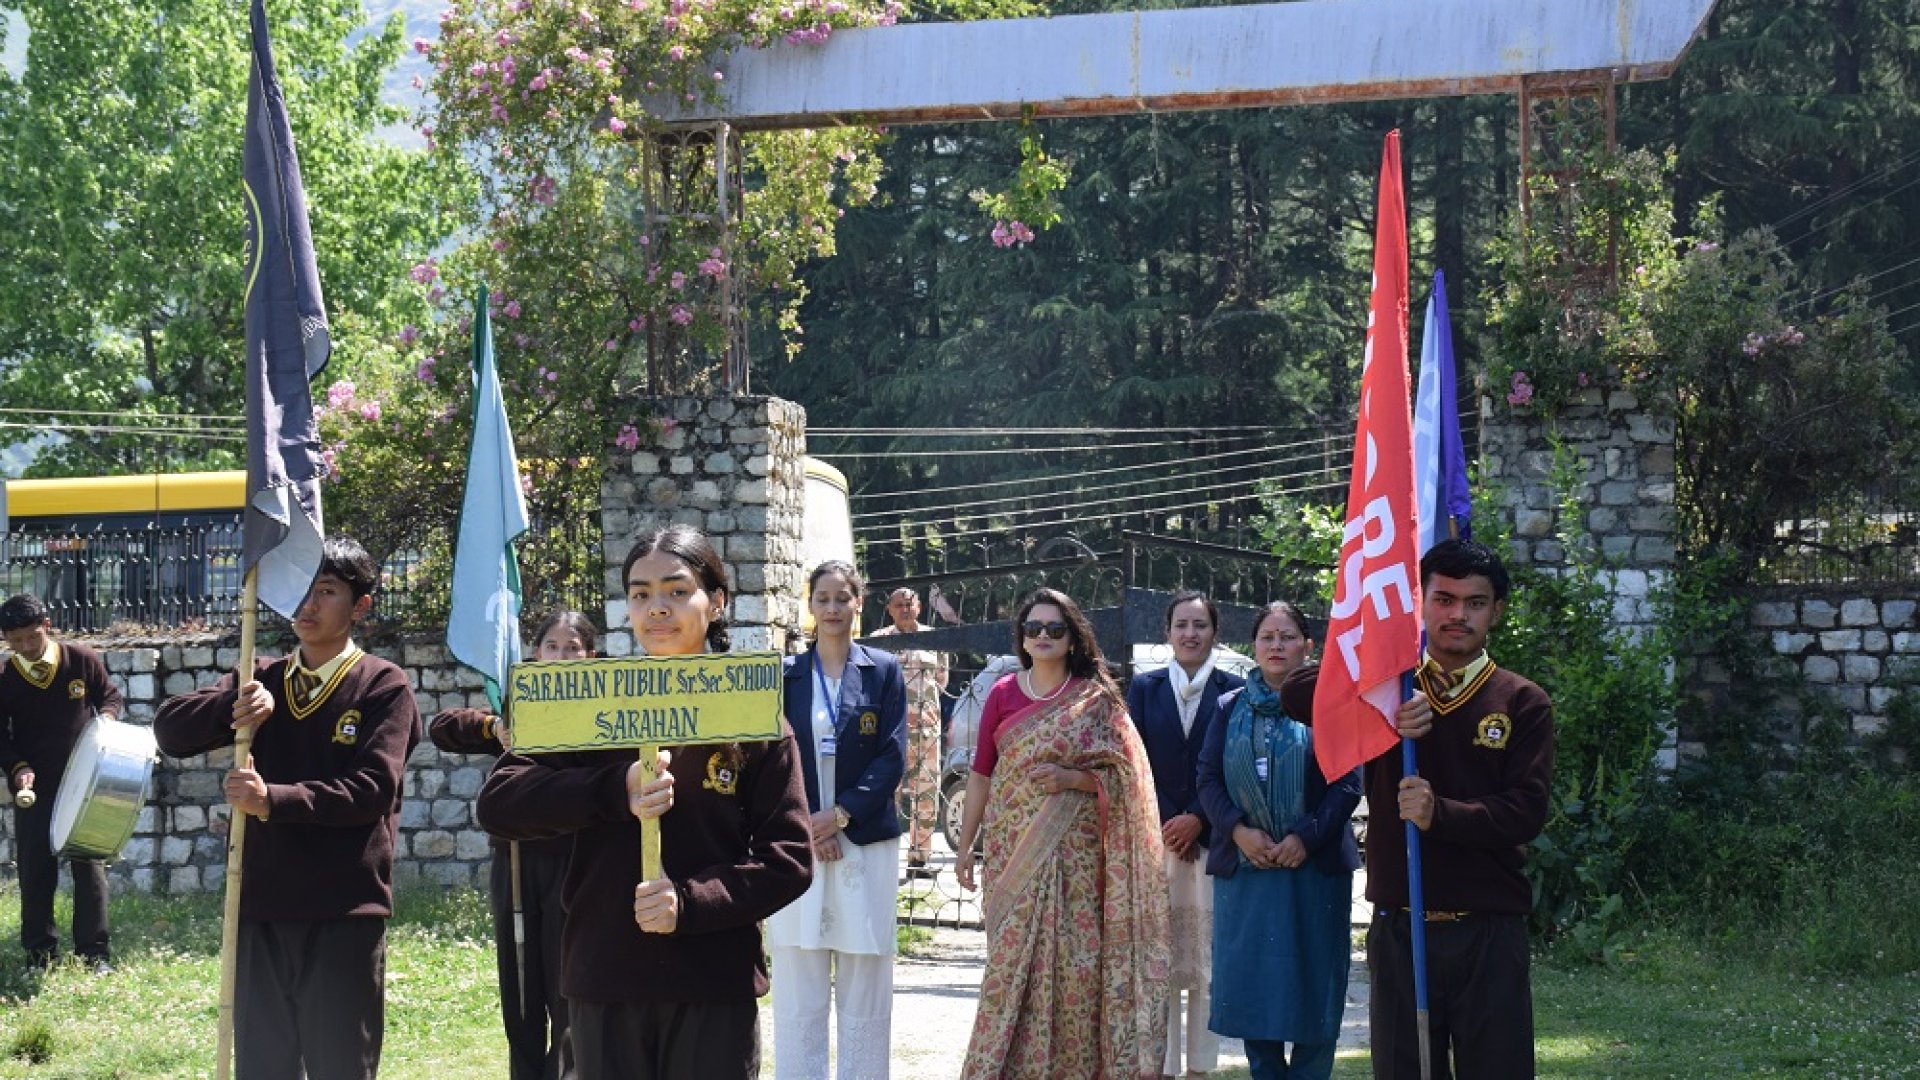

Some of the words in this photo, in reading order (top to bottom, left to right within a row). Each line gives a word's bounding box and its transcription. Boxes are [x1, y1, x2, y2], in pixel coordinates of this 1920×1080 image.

[516, 669, 607, 702] SARAHAN
[613, 668, 673, 698] PUBLIC
[594, 706, 700, 741] SARAHAN
